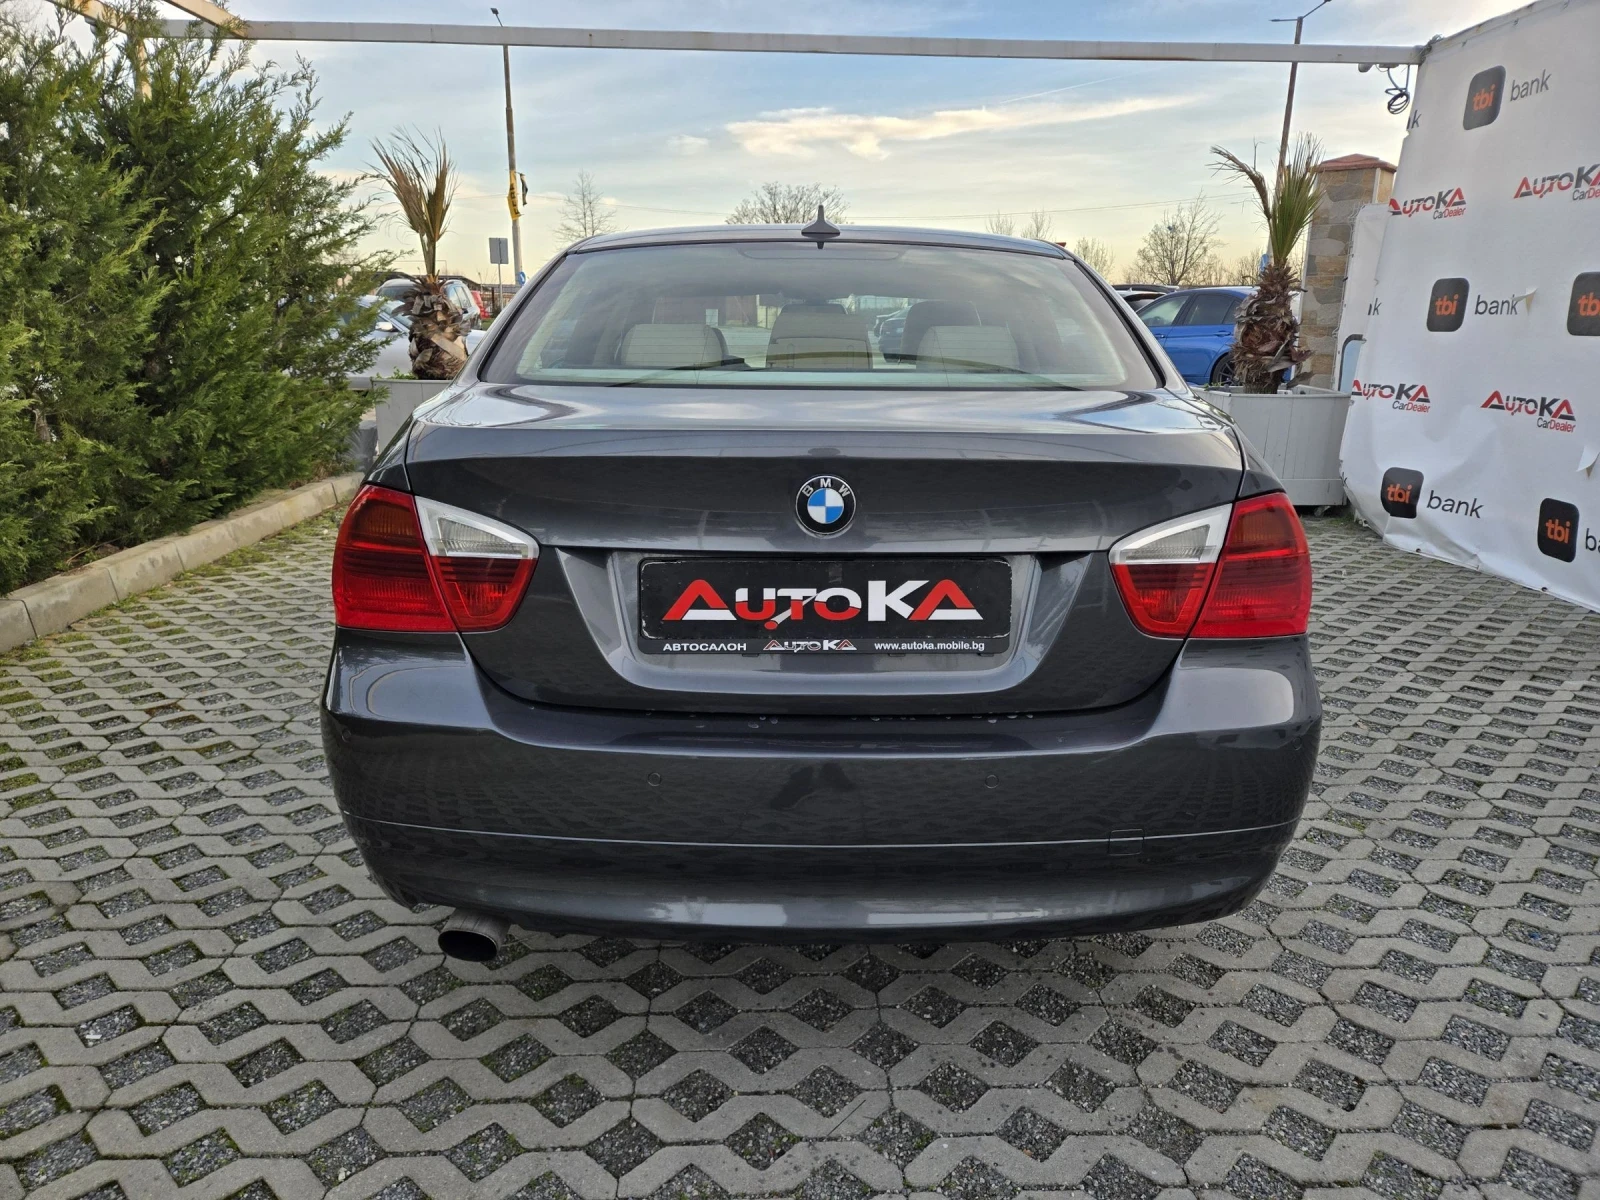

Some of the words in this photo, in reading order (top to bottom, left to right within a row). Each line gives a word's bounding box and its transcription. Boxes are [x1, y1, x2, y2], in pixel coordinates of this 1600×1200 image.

[1472, 84, 1496, 111] tbi
[1510, 69, 1552, 101] bank
[1433, 207, 1466, 220] CarDealer
[1435, 294, 1459, 316] tbi
[1474, 294, 1519, 315] bank
[1392, 400, 1431, 413] CarDealer
[1537, 417, 1576, 433] CarDealer
[802, 478, 850, 497] BMW
[1387, 484, 1412, 504] tbi
[1426, 490, 1484, 519] bank
[1545, 518, 1571, 544] tbi
[663, 642, 747, 652] АВТОСАЛОН
[873, 641, 986, 653] www.autoka.mobile.bg
